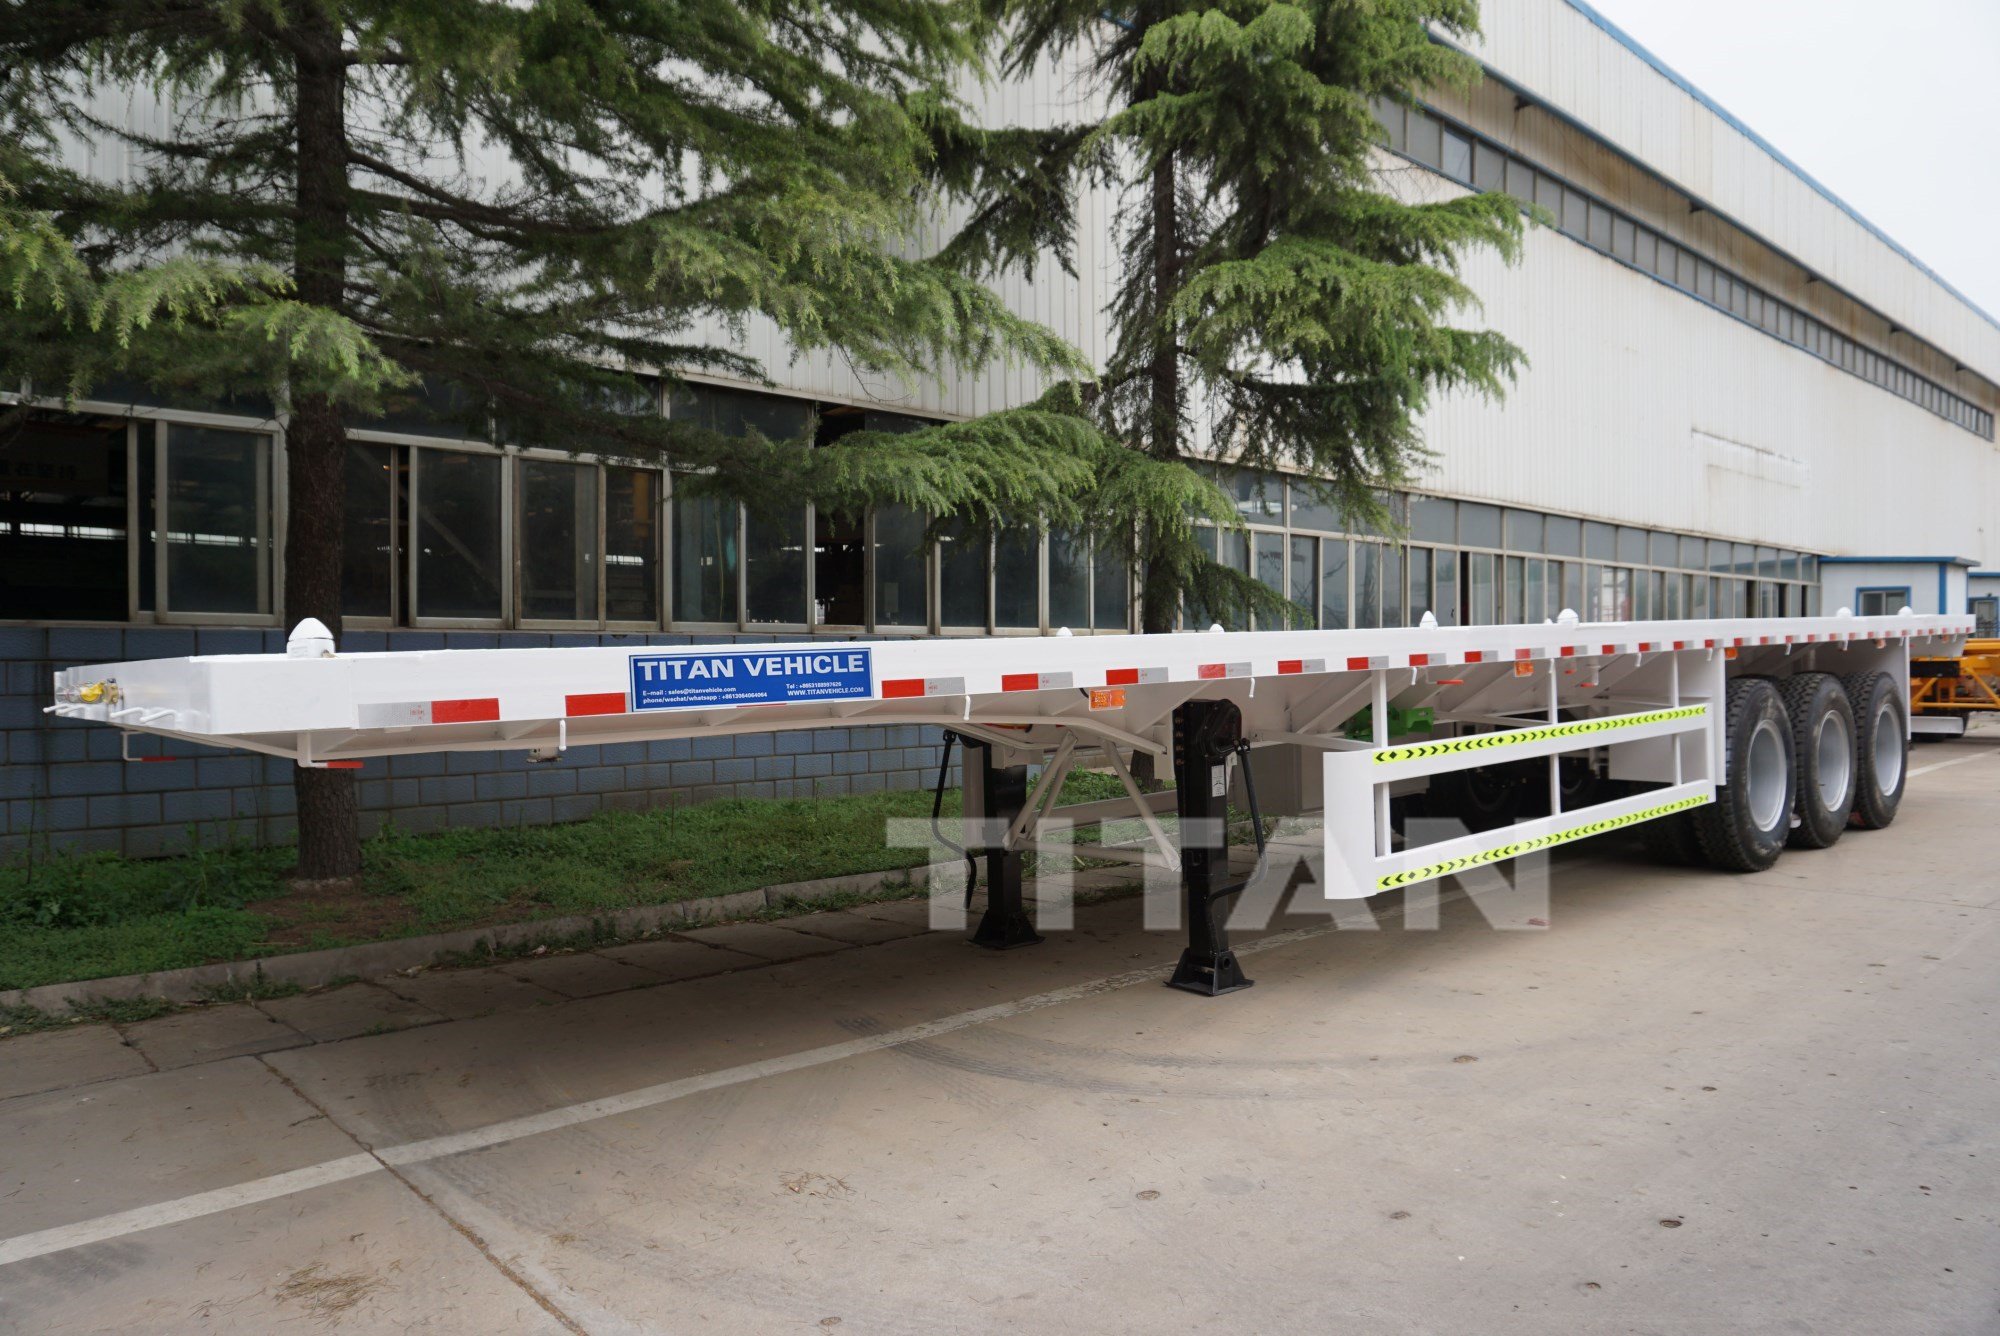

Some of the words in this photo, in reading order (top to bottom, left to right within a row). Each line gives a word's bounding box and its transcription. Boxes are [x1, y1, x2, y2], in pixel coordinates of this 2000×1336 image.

[638, 658, 734, 681] TITAN
[743, 655, 864, 676] VEHICLE
[668, 687, 736, 695] sales@titanvehicle.com
[787, 687, 864, 696] WWW.TITANVEHICLE.COM
[643, 695, 717, 704] phone/wechat/whatsapp
